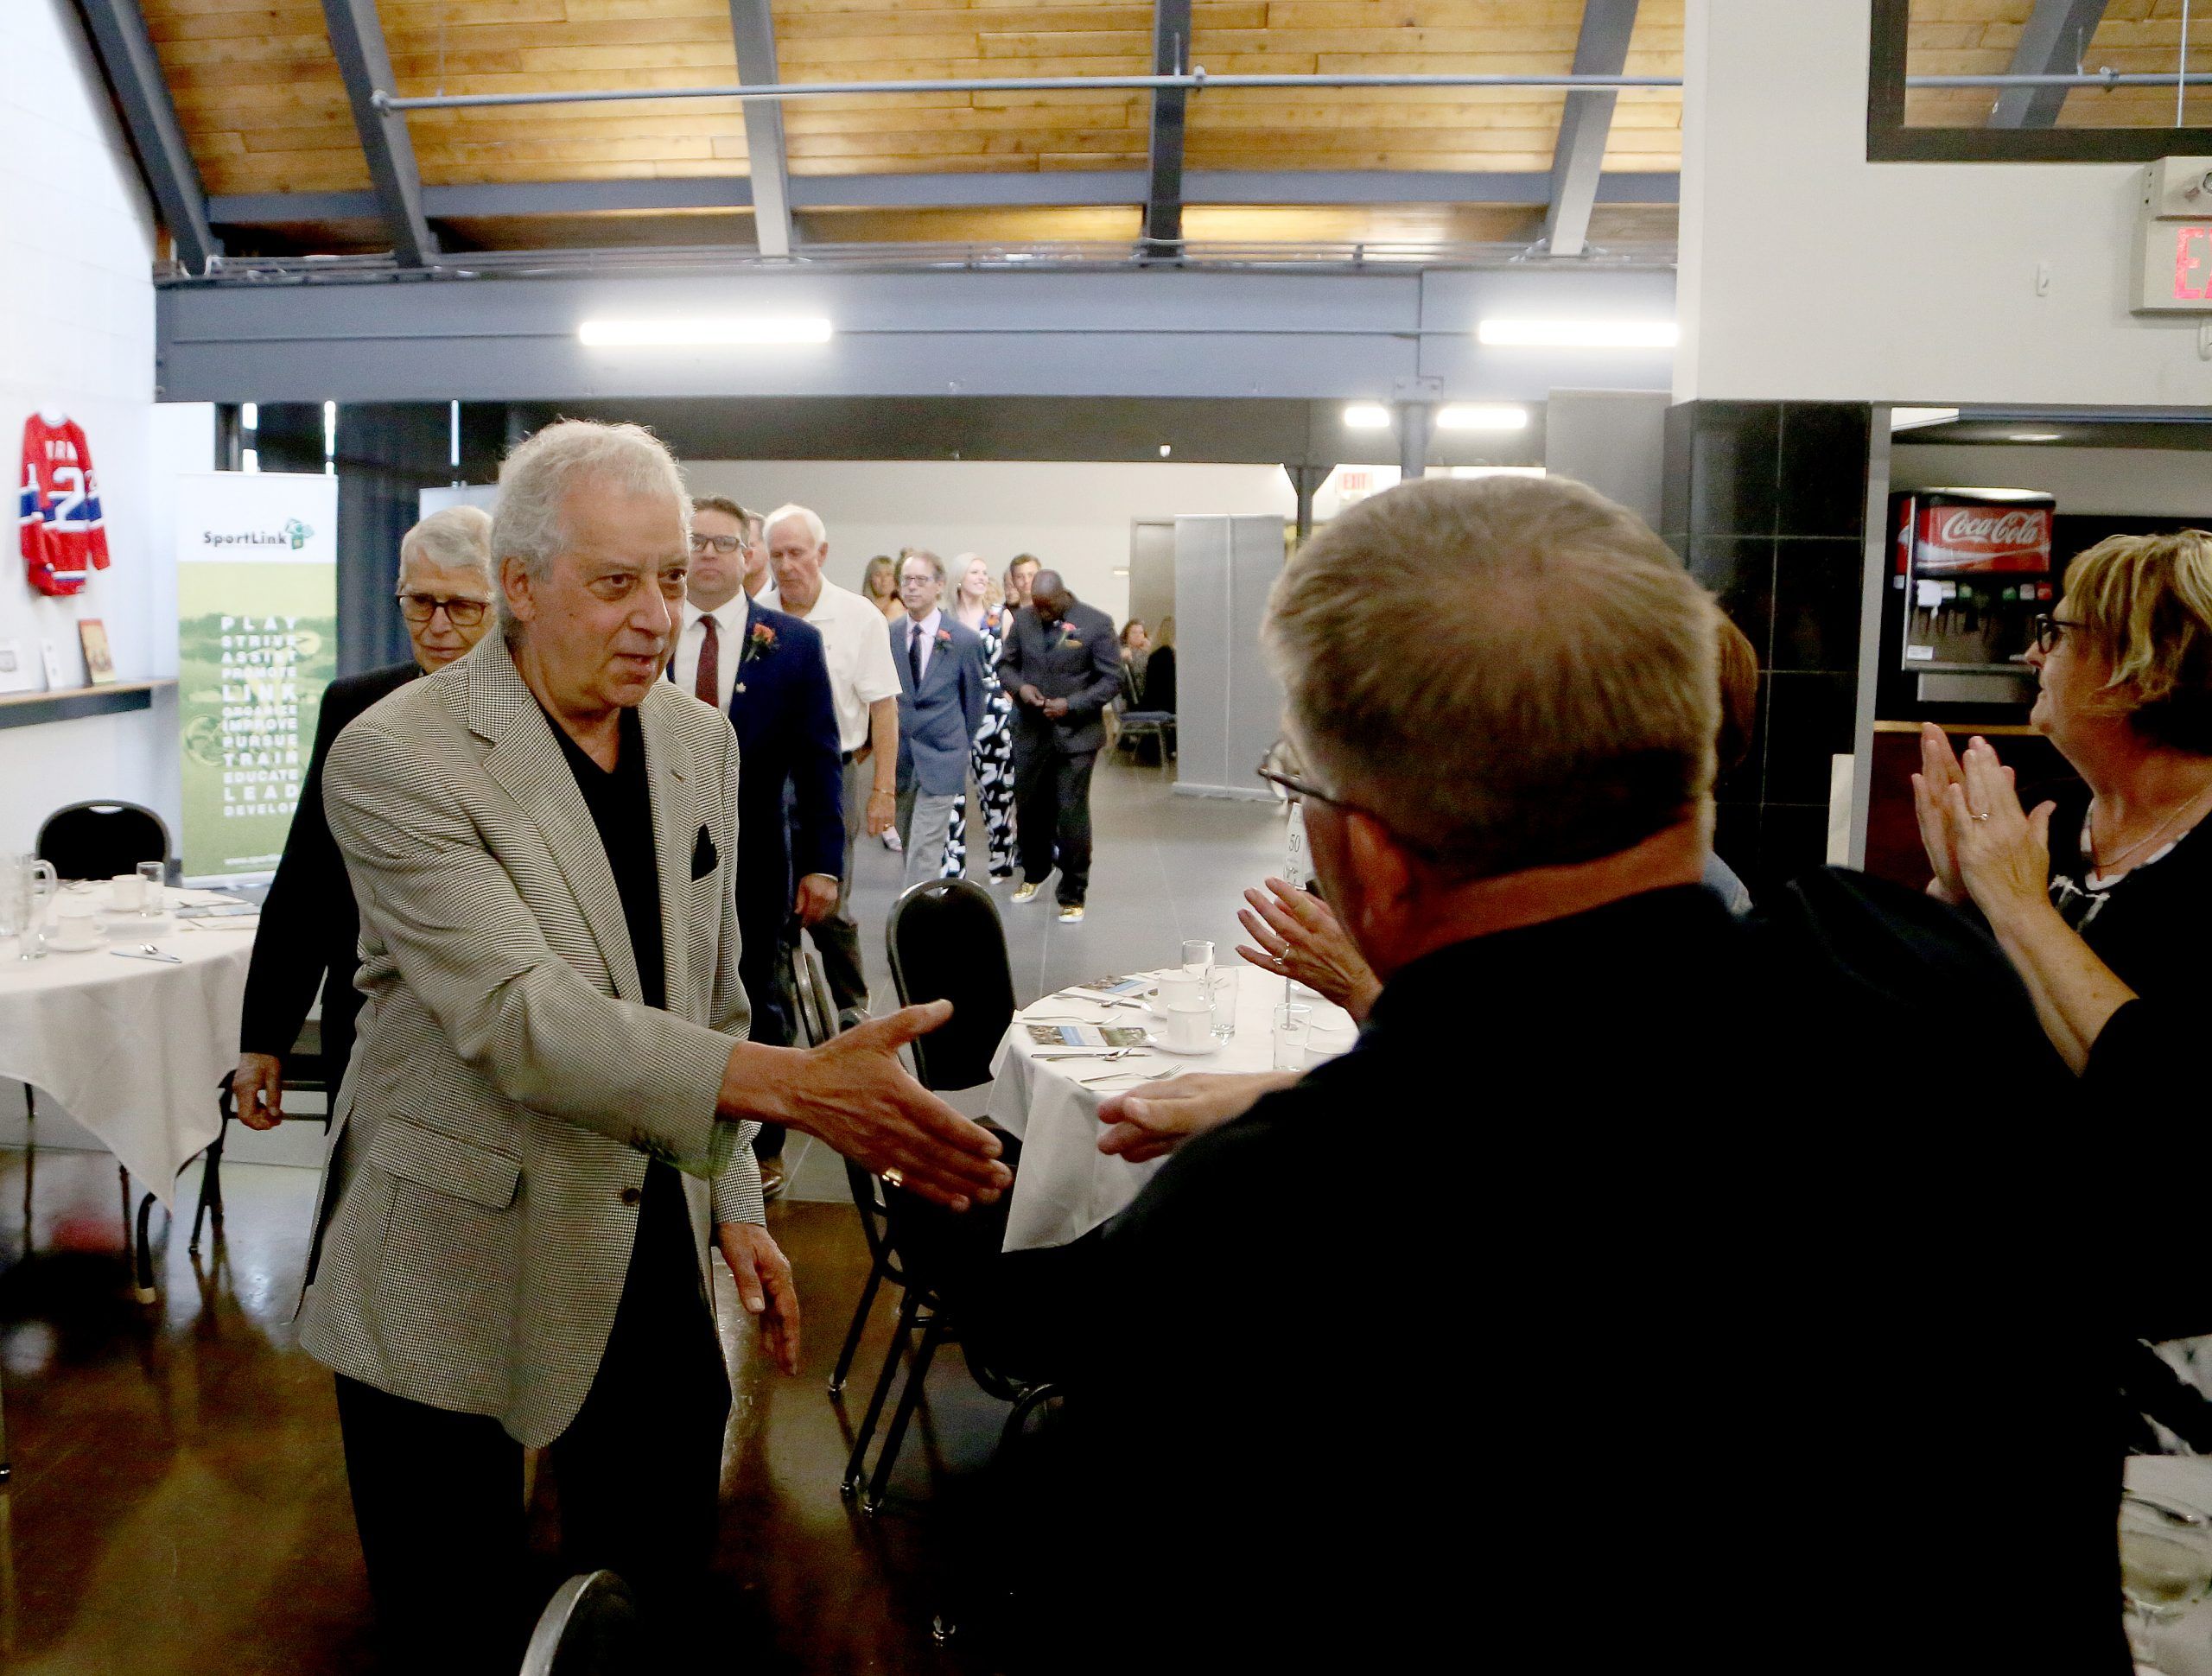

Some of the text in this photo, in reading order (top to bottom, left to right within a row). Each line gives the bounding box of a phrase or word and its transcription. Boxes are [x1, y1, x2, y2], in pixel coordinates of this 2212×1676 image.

[1344, 473, 1366, 490] EXIT
[1942, 511, 2045, 544] Coca-Cola
[204, 531, 286, 547] SportLink
[220, 615, 296, 632] PLAY
[220, 634, 296, 650] STRIVE
[221, 650, 296, 664] ASSIST
[221, 666, 297, 681] PROMOTE
[221, 683, 298, 702] LINK
[221, 717, 298, 734] IMPROVE
[221, 733, 298, 749] PURSUE
[222, 751, 298, 768] TRAIN
[223, 769, 298, 784] EDUCATE
[223, 784, 299, 803] LEAD
